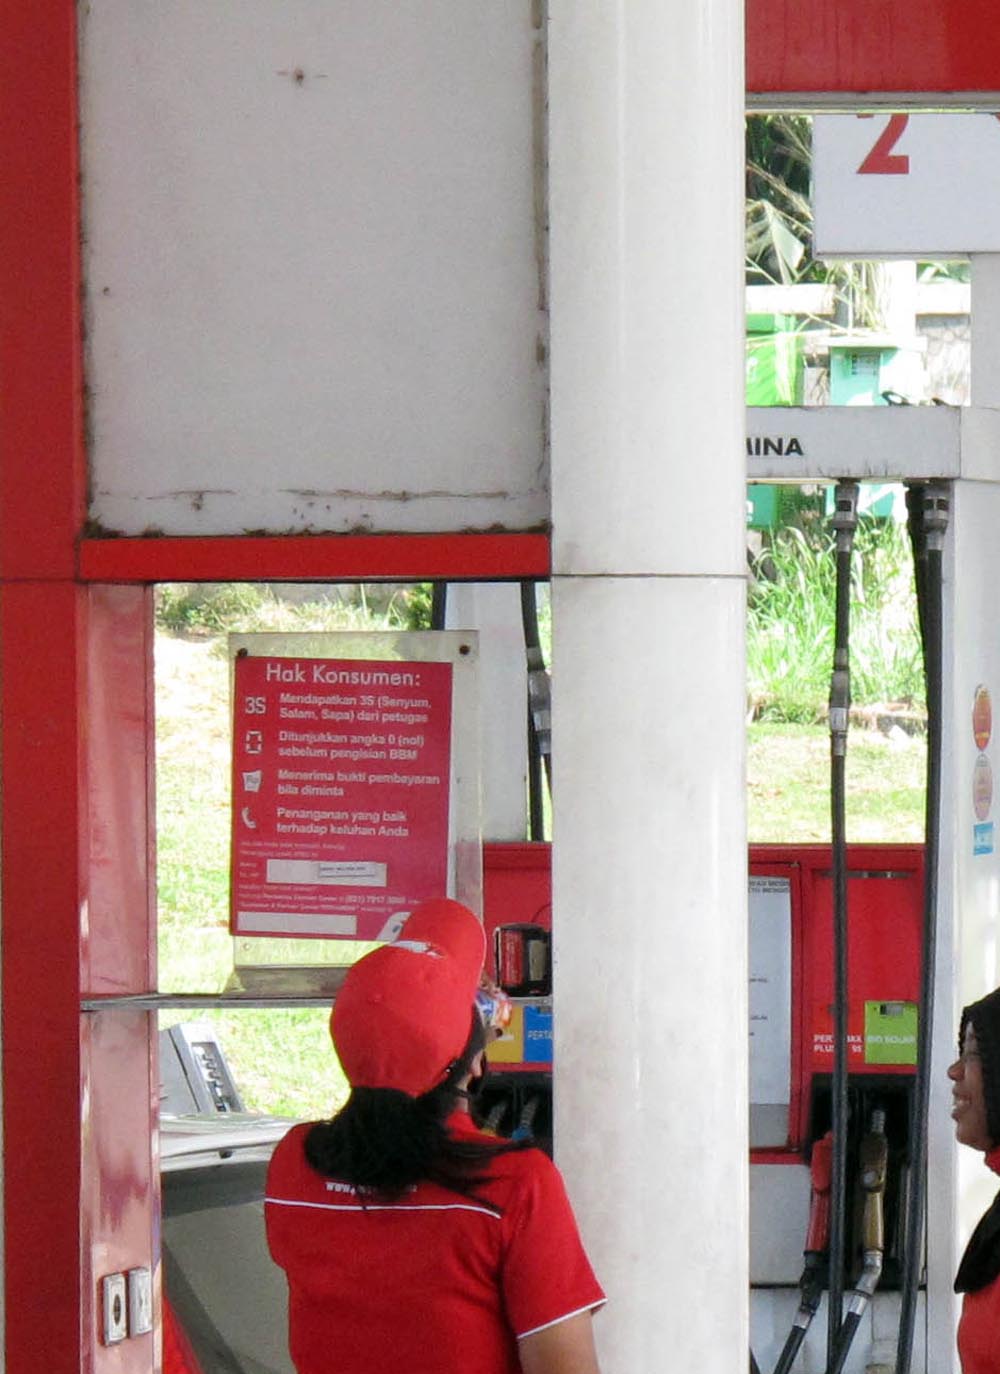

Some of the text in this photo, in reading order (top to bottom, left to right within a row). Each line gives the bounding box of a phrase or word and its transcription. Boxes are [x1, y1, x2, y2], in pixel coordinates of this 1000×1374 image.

[266, 663, 421, 687] Hak Konsumen:
[245, 697, 266, 714] 3S
[280, 693, 357, 706] Mendapatkan
[359, 695, 375, 706] 3S
[357, 710, 380, 721] dari
[382, 711, 428, 724] petugas
[279, 730, 348, 744] Ditunjukkan
[351, 734, 386, 747] angka
[278, 746, 418, 760] sebelum pengisian BBM
[278, 769, 440, 786] Menerima bukti pembayaran
[277, 784, 344, 797] bila diminta
[276, 807, 407, 823] Penanganan yang baik
[276, 822, 409, 837] terhadap keluhan Anda
